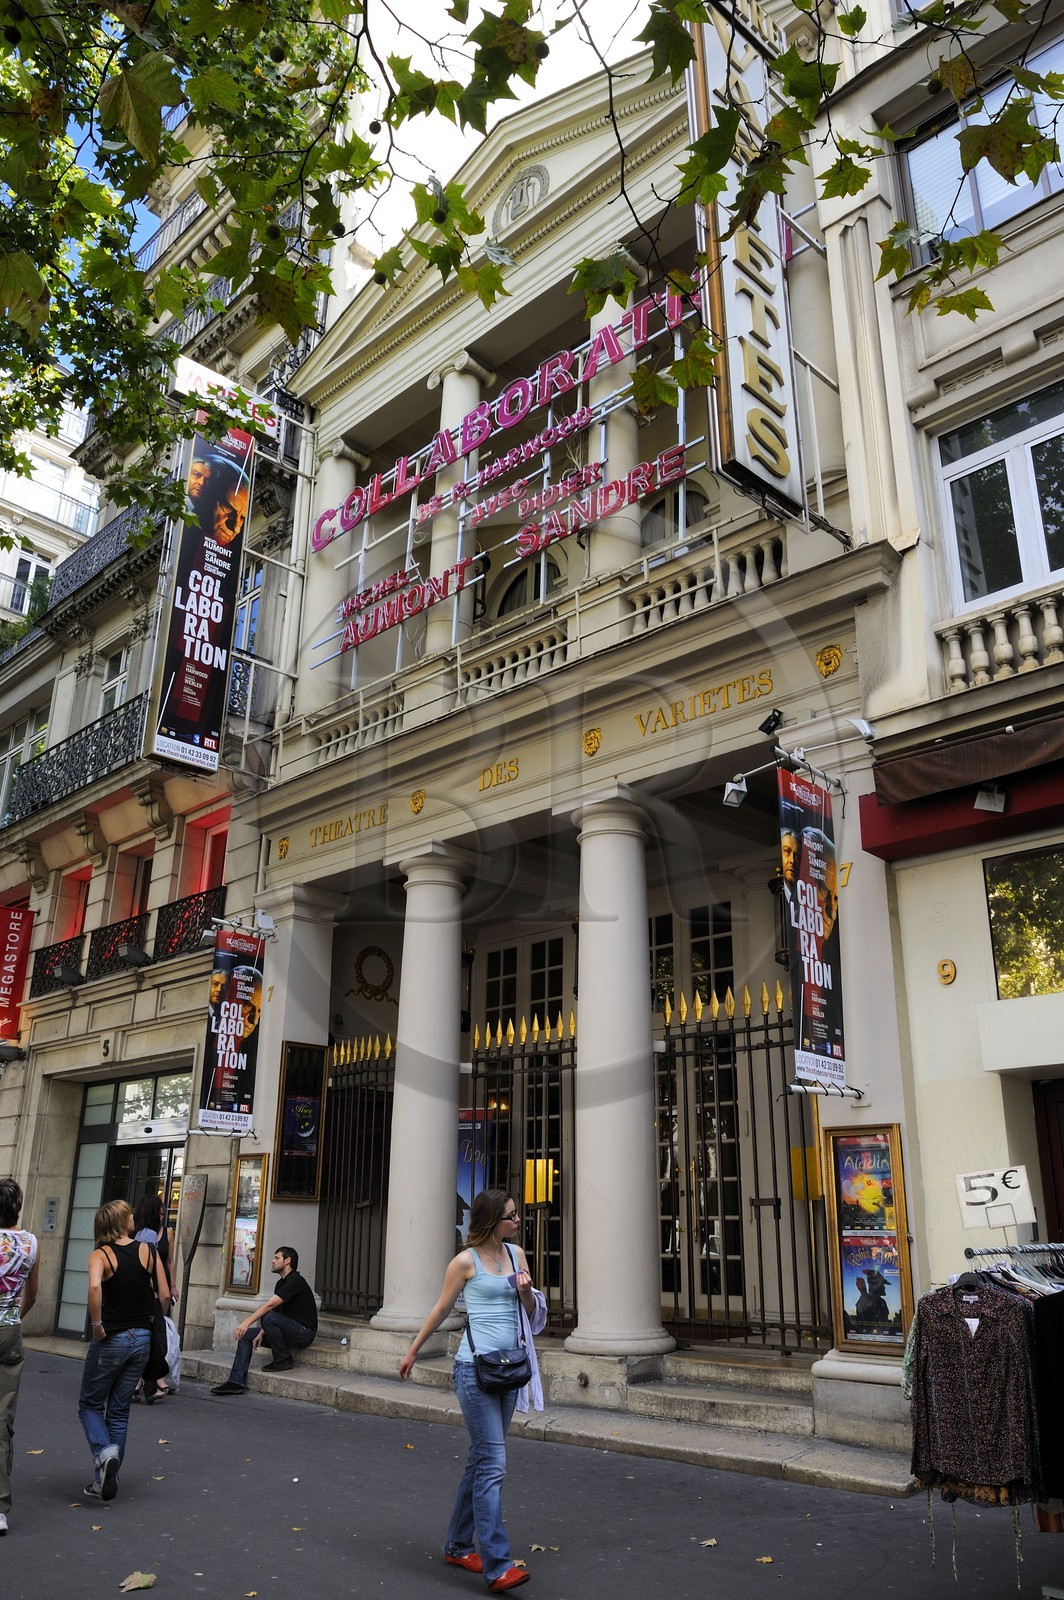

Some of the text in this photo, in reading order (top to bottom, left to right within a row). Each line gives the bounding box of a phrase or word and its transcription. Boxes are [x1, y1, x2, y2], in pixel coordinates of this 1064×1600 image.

[706, 3, 790, 480] VARETES
[477, 406, 593, 488] HARWOOD
[471, 478, 529, 527] AVEC
[515, 444, 686, 558] SANDRE
[518, 461, 602, 520] DIDIER
[203, 541, 233, 558] AUMONT
[204, 554, 232, 571] SANDRE
[188, 569, 224, 603] COL
[338, 569, 410, 619] MICHEL
[174, 586, 223, 624] LABO
[339, 557, 472, 653] AUMONT
[183, 612, 209, 642] RA
[183, 634, 228, 671] TION
[156, 740, 181, 752] LOCATION
[188, 748, 196, 757] 42
[204, 737, 217, 749] RTL
[309, 668, 775, 848] THEATRE DES VARIETES
[839, 862, 853, 887] 7
[796, 879, 822, 913] COL
[789, 901, 824, 937] LABO
[0, 911, 23, 1008] MEGASTORE
[800, 930, 818, 960] RA
[801, 955, 833, 990] TION
[936, 958, 957, 986] 9
[210, 1016, 245, 1037] LABO
[220, 1000, 245, 1021] COL
[102, 1039, 110, 1057] 5
[216, 1033, 236, 1052] RA
[216, 1049, 248, 1071] TION
[844, 1154, 891, 1171] Aladin
